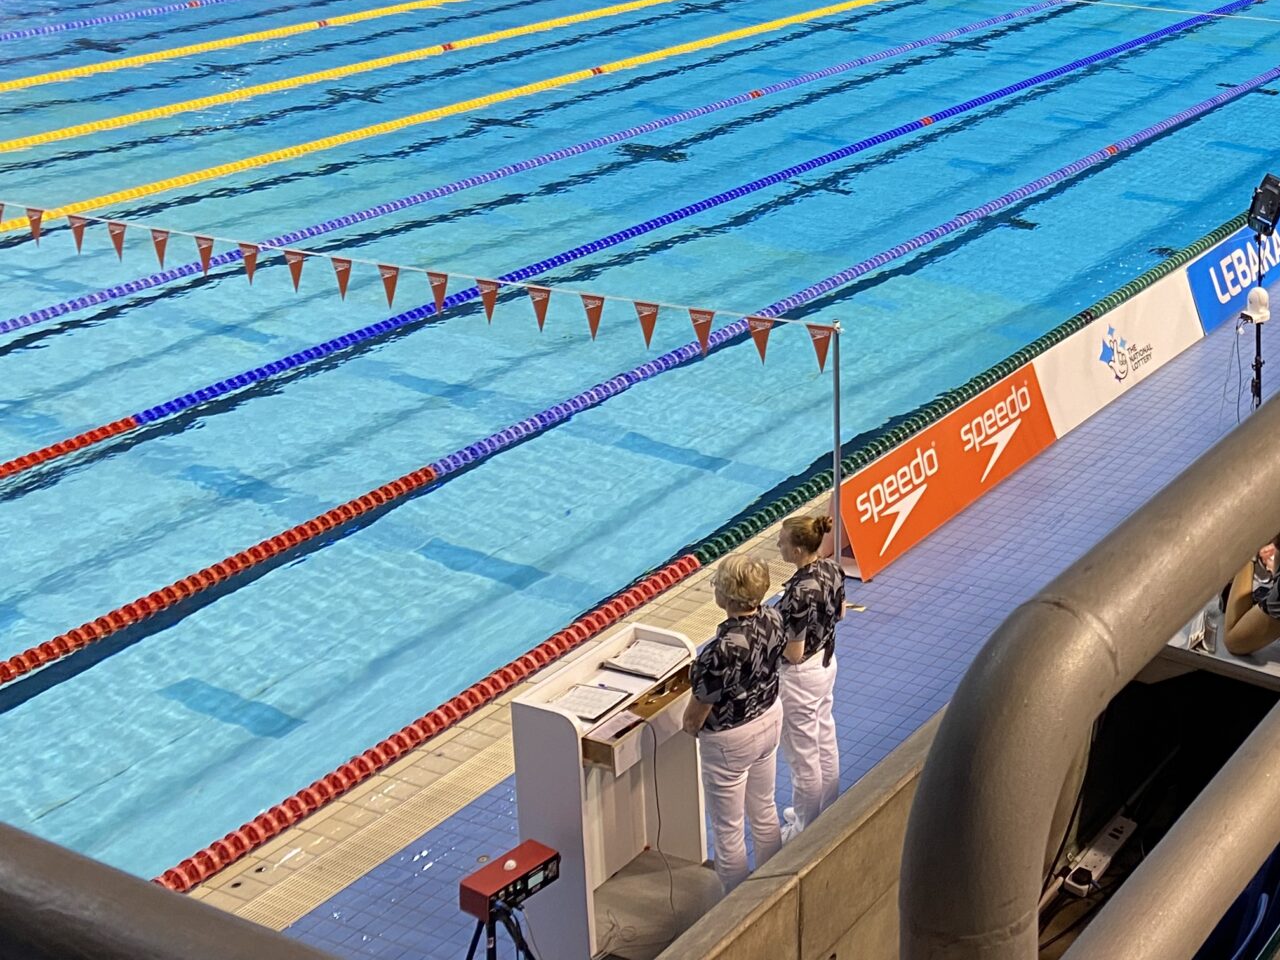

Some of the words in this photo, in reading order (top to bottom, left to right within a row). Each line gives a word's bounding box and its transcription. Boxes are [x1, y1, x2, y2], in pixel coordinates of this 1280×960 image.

[1127, 344, 1137, 354] THE
[1129, 344, 1153, 362] NATIONAL
[1131, 352, 1152, 371] LOTTERY
[960, 385, 1031, 452] speedo
[856, 447, 939, 523] speedo
